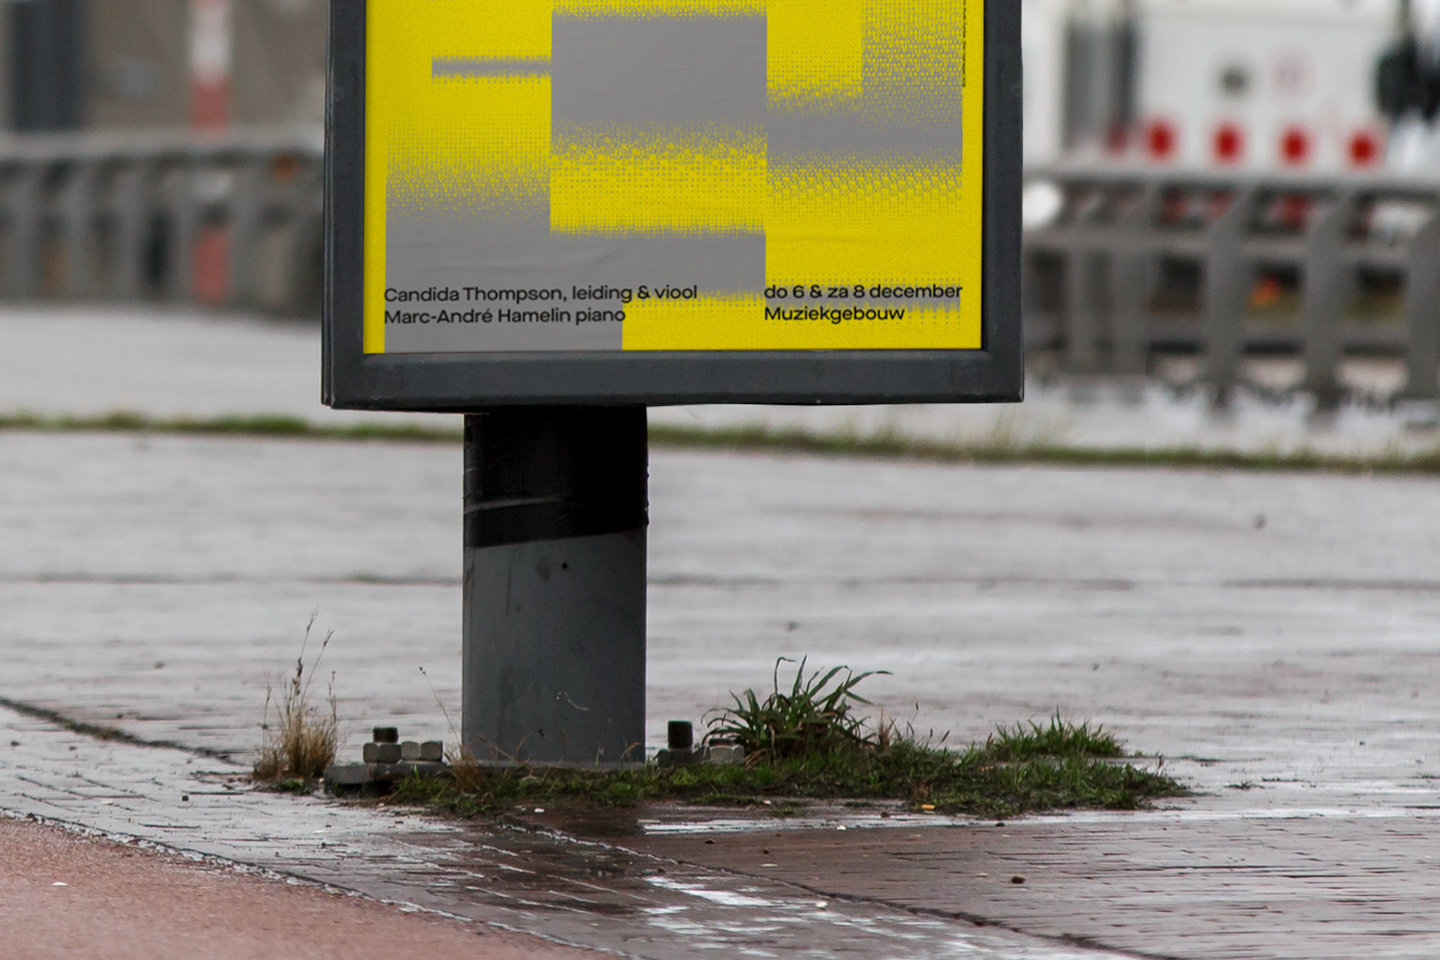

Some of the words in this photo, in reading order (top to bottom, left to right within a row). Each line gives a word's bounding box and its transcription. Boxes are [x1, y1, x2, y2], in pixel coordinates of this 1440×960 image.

[384, 286, 459, 302] Candida
[462, 286, 568, 304] Thompson,
[572, 285, 633, 304] leiding
[637, 285, 651, 299] &
[654, 284, 698, 299] viool
[764, 284, 788, 299] do
[792, 285, 805, 298] 6
[810, 285, 823, 298] &
[827, 287, 849, 299] za
[853, 285, 866, 298] 8
[869, 284, 963, 299] december
[384, 308, 494, 324] Marc-André
[497, 307, 571, 323] Hamelin
[575, 307, 626, 325] piano
[764, 305, 905, 324] Muziekgebouw
